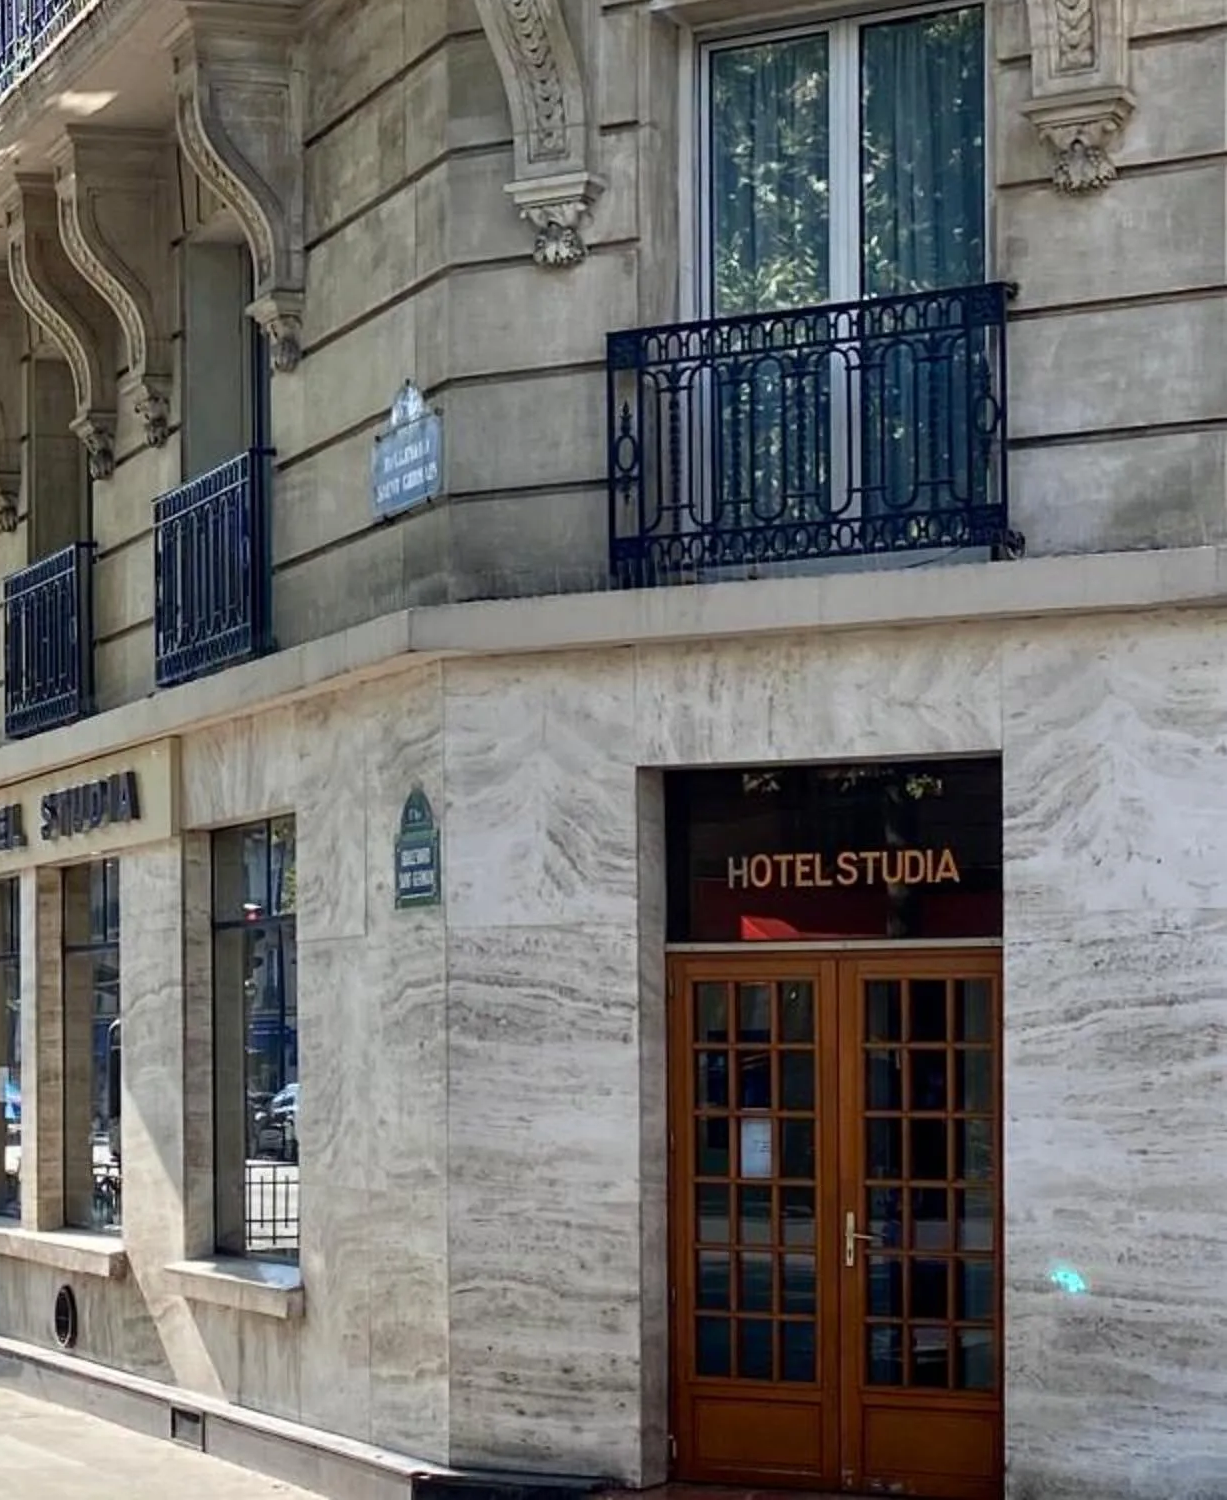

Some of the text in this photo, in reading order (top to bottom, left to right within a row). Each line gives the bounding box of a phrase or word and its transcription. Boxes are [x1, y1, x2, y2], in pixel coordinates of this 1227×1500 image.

[40, 771, 141, 841] STUDIA
[728, 849, 961, 889] HOTEL STUDIA
